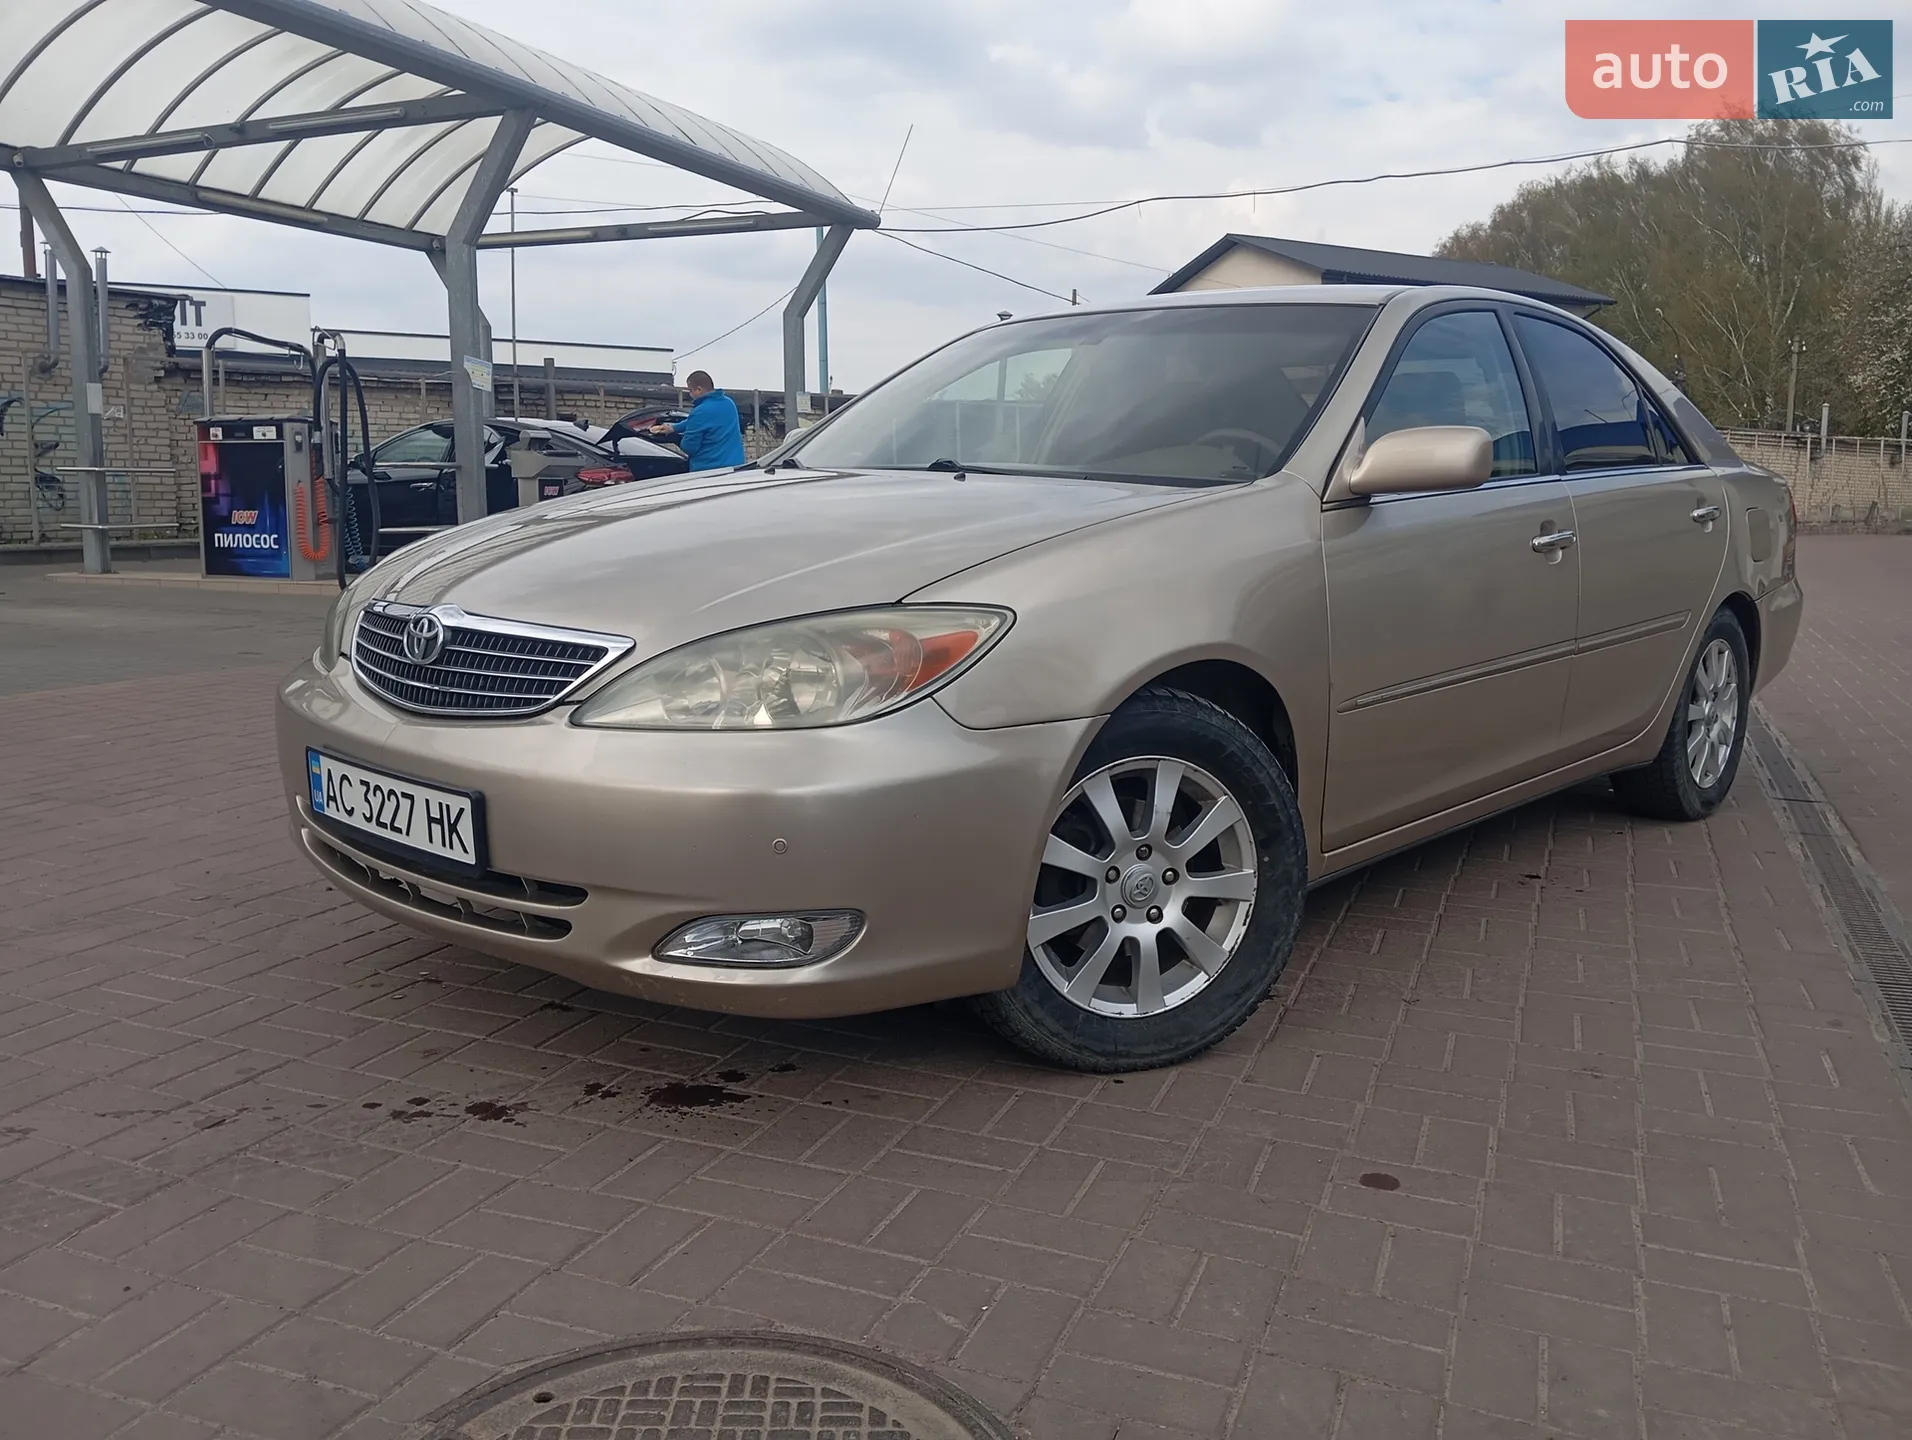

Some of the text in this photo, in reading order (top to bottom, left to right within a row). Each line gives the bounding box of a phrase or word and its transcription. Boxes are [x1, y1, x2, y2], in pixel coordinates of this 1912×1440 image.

[184, 332, 195, 340] 33
[197, 332, 208, 340] 00
[214, 533, 279, 549] ПИЛОСОС
[326, 767, 470, 855] AC 3227 HK
